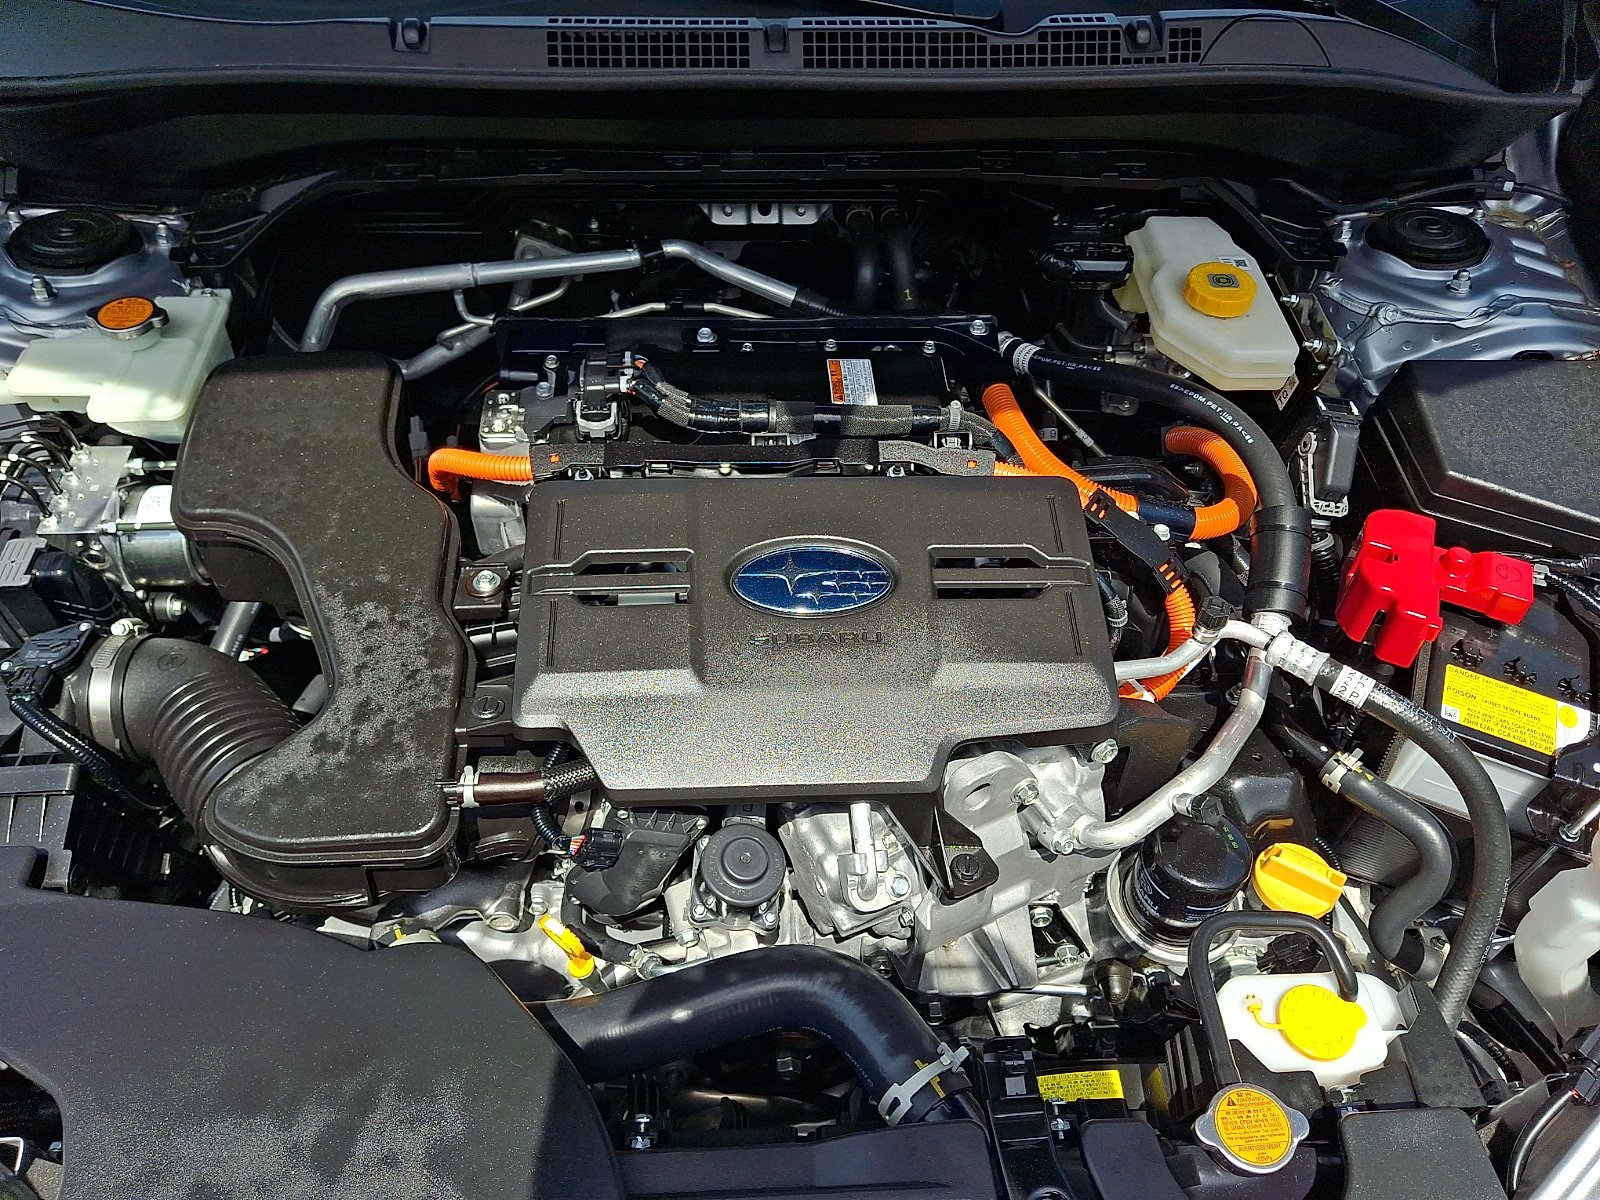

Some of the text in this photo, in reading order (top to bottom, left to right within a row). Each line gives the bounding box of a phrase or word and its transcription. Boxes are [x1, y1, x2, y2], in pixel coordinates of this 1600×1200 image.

[903, 288, 913, 301] 1
[748, 631, 882, 646] SUBARU
[1449, 667, 1479, 681] DANGER
[1482, 678, 1510, 691] EXPLOSIVE
[1447, 686, 1541, 721] POISON CAUSES SEVERE BURNS
[1467, 708, 1479, 716] KEEP
[1482, 711, 1494, 720] VENT
[1496, 716, 1509, 726] CAPS
[1511, 721, 1526, 732] TIGHT
[1527, 727, 1537, 735] AND
[1539, 731, 1554, 741] LEVEL
[1497, 728, 1511, 739] CCA
[1501, 722, 1519, 733] REACH
[1528, 732, 1554, 745] CHILDREN
